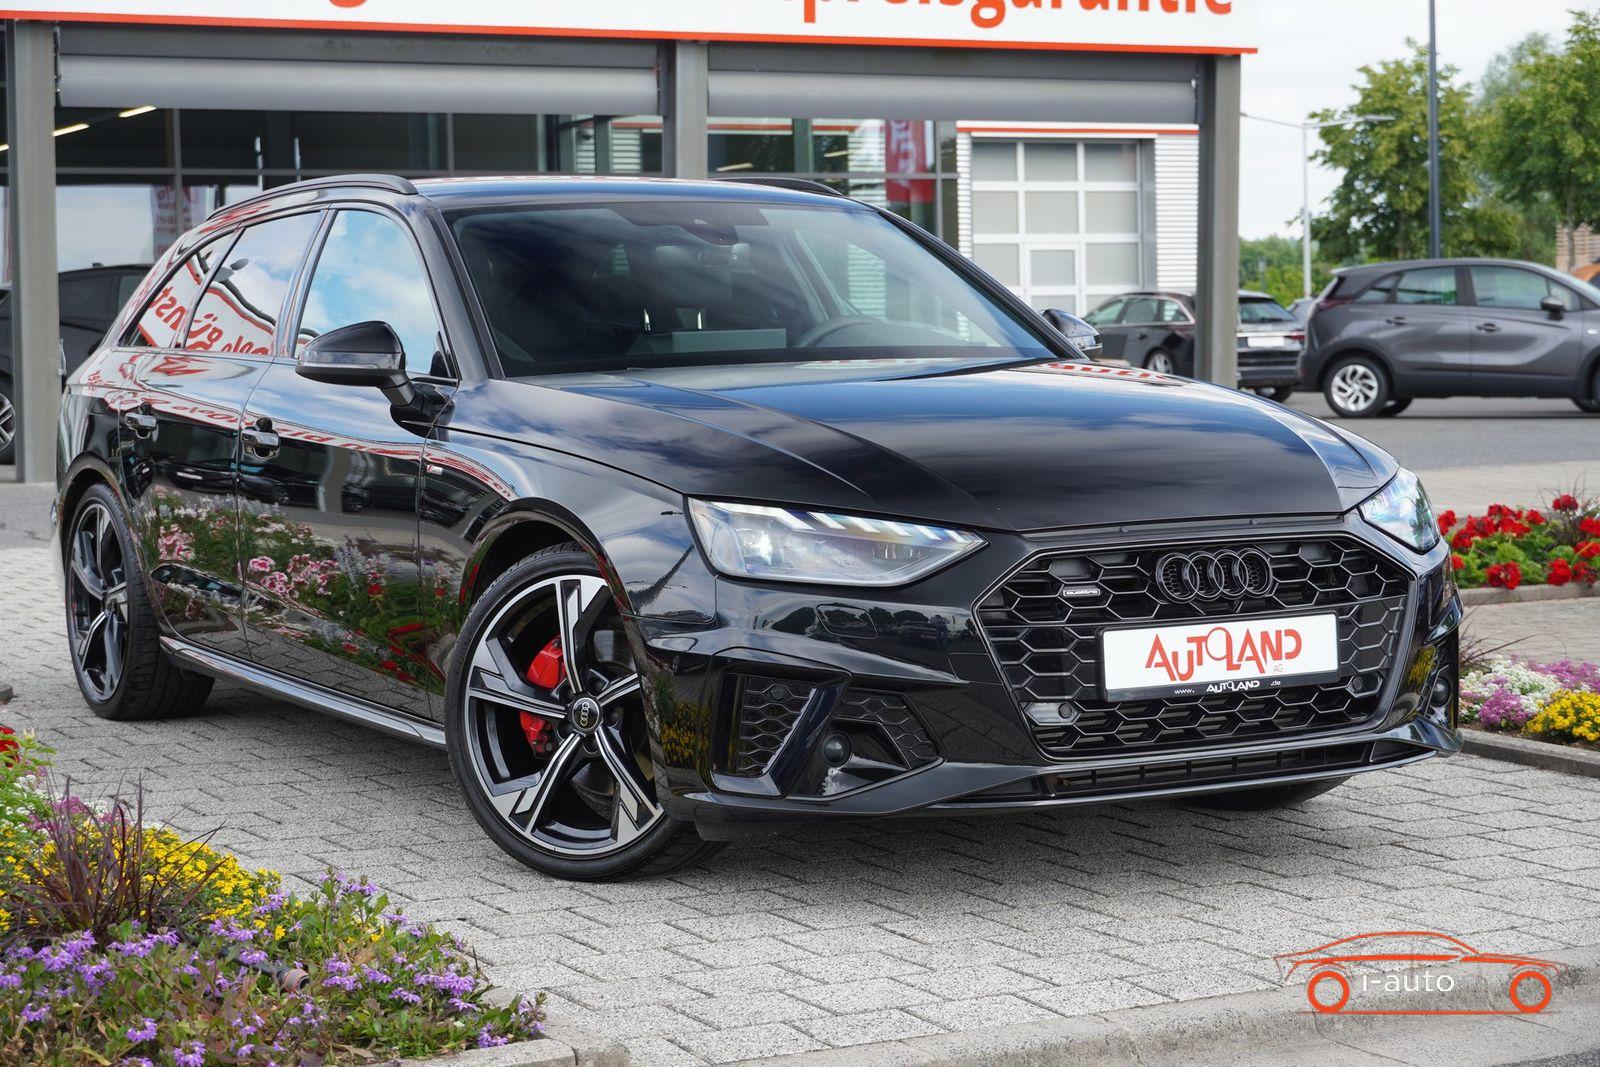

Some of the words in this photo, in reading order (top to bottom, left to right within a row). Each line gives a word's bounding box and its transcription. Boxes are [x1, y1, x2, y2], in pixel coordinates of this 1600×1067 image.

[1145, 626, 1302, 681] AUTOLAND
[1273, 664, 1284, 673] AG
[1206, 680, 1260, 693] AUTOLAND
